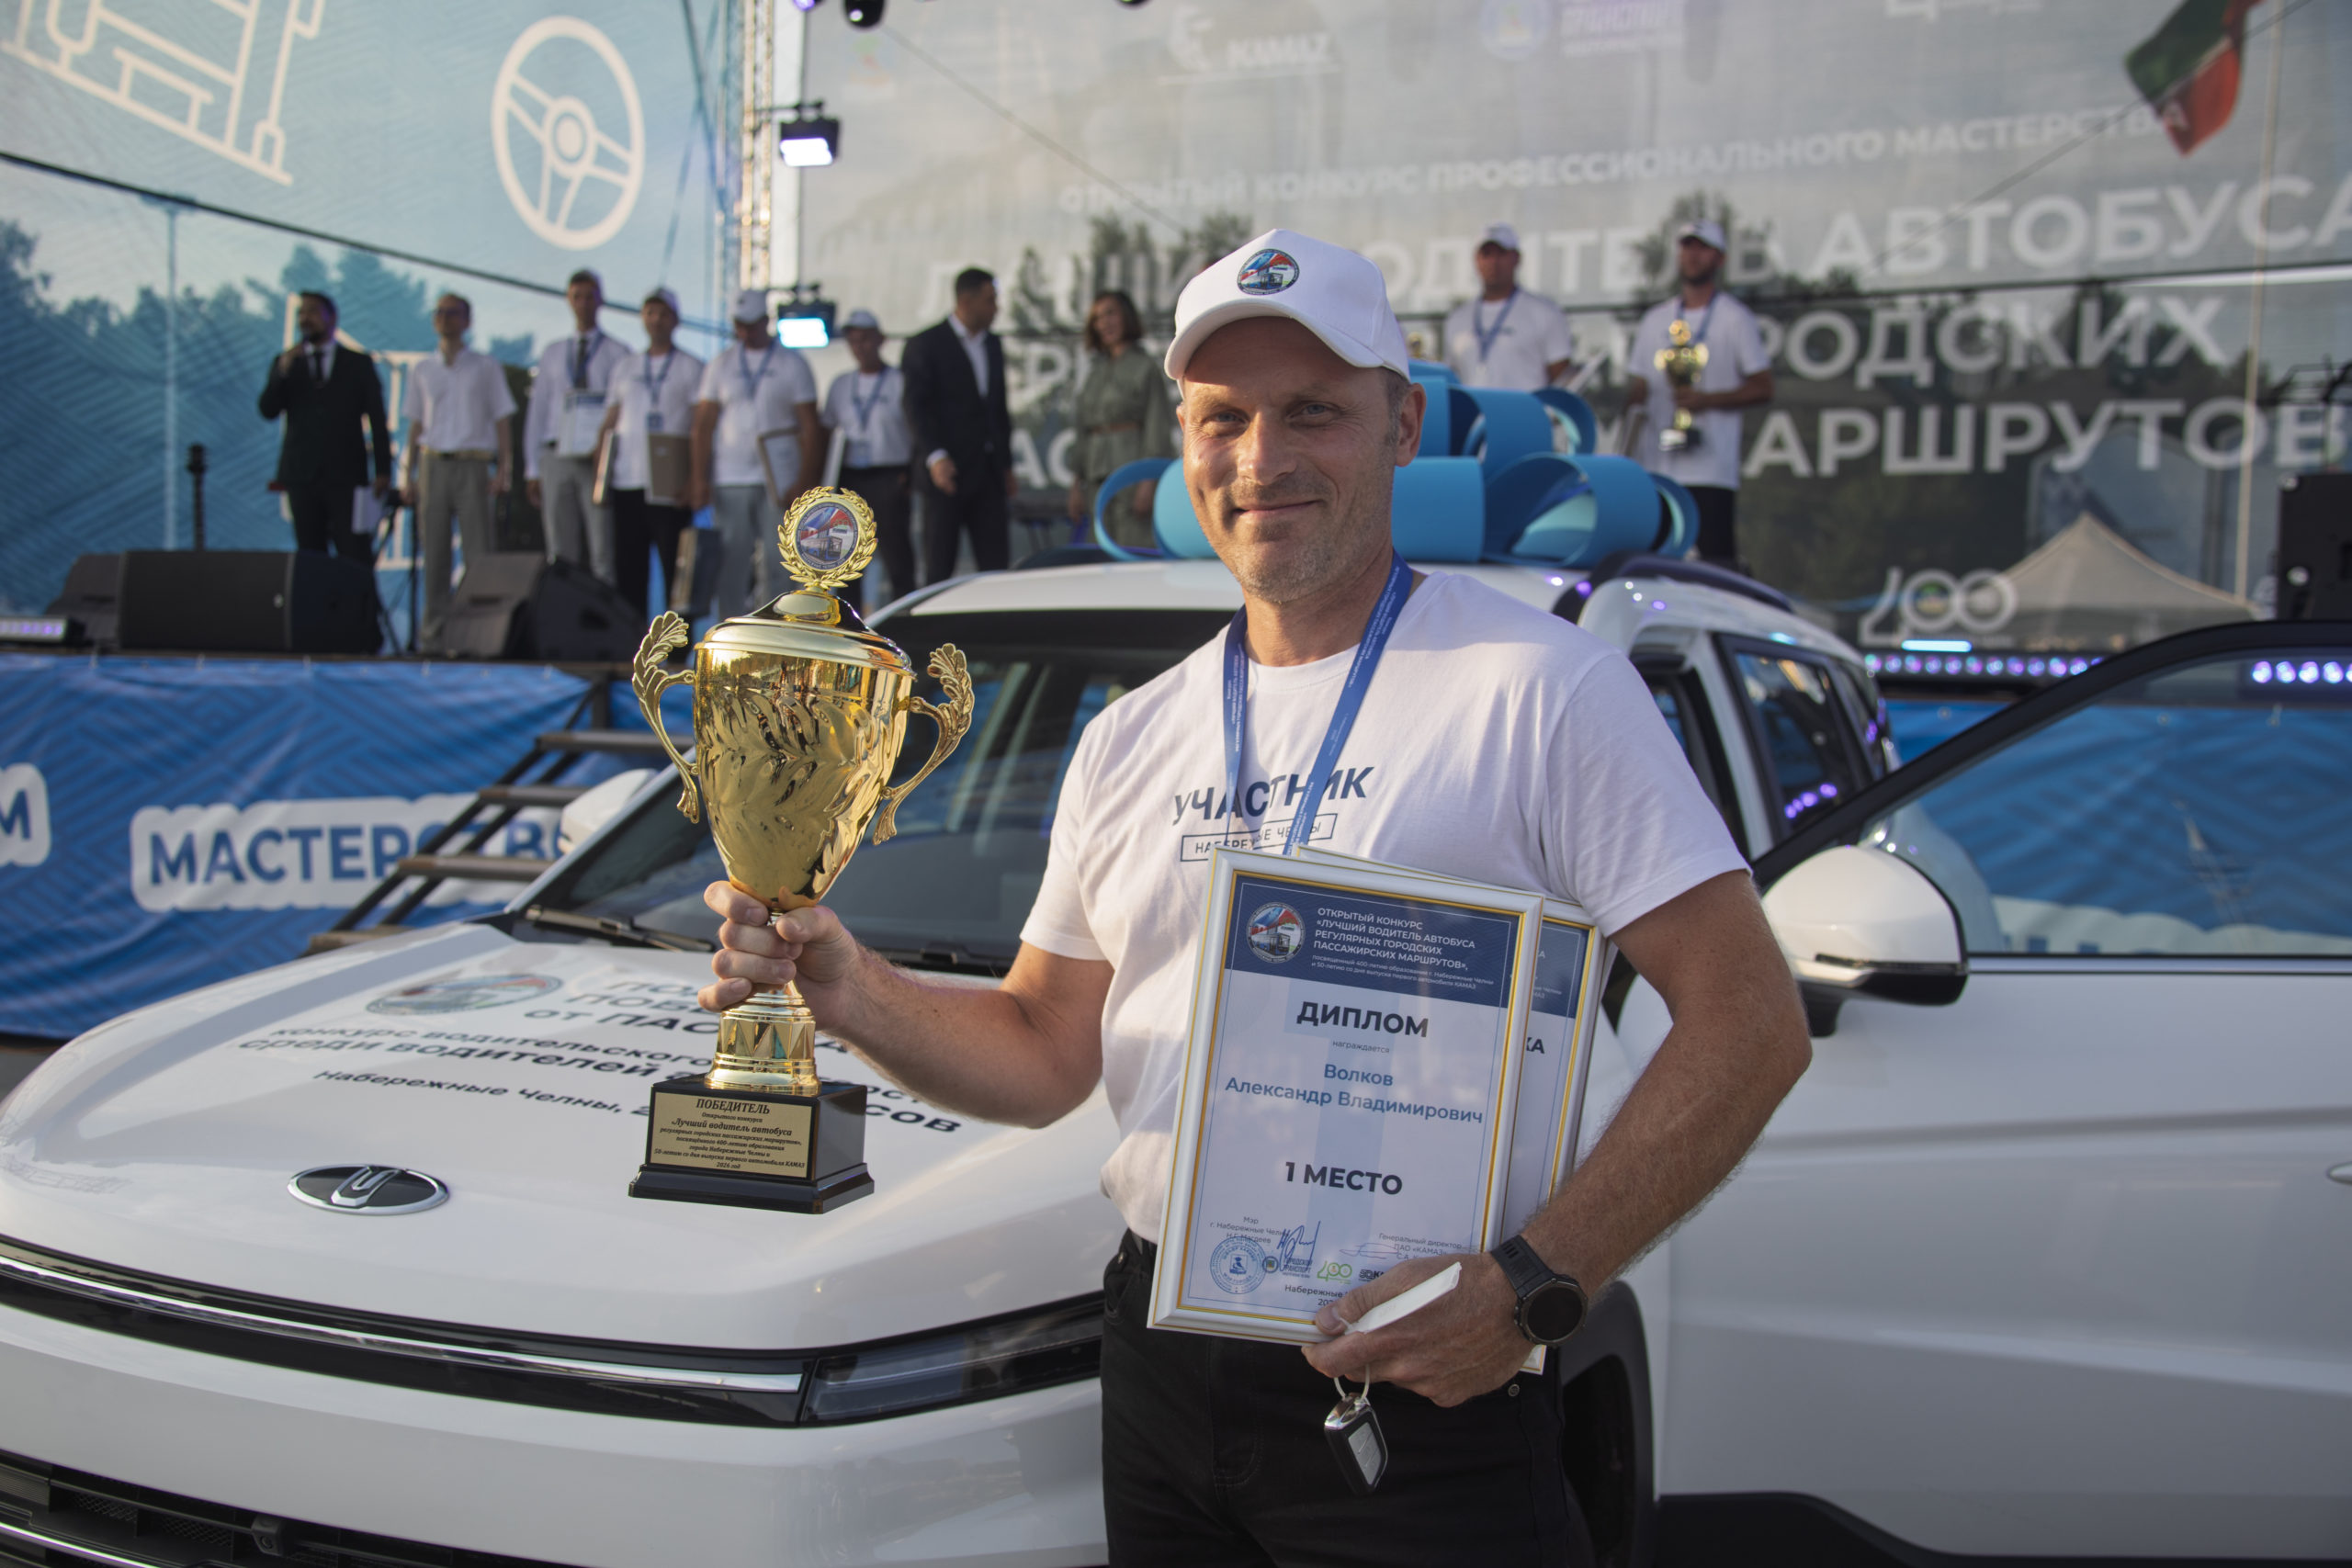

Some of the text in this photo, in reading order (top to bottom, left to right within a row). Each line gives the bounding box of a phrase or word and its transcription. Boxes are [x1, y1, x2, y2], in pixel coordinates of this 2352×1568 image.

[1258, 162, 1422, 200] КОНКУРС
[1427, 129, 1885, 191] ПРОФЕССИОНАЛЬНОГО
[1894, 103, 2187, 158] МАСТЕРСТВА
[1746, 396, 2331, 478] АРШРУТОВ
[1317, 908, 1423, 930] ОТКРЫТЫЙ КОНКУРС
[1315, 930, 1442, 955] РЕГУЛЯРНЫХ ГОРОДСКИХ
[1317, 919, 1476, 949] «ЛУЧШИЙ ВОДИТЕЛЬ АВТОБУСА
[1314, 940, 1469, 971] ПАССАЖИРСКИХ МАРШРУТОВ»,
[1434, 971, 1474, 982] Набережные
[1296, 1001, 1429, 1038] ДИПЛОМ
[1332, 1040, 1390, 1055] награждается
[1324, 1064, 1394, 1087] Волков
[313, 1069, 622, 1113] Набережные Челны,
[1225, 1077, 1483, 1123] Александр Владимирович
[695, 1098, 770, 1114] ПОБЕДИТЕЛЬ
[708, 1121, 750, 1133] водитель
[752, 1126, 793, 1137] автобуса
[785, 1160, 805, 1168] КАМАЗ
[1285, 1161, 1403, 1195] 1 МЕСТО
[1216, 1222, 1265, 1234] Набережные
[1243, 1216, 1259, 1224] Мэр
[1378, 1233, 1462, 1249] Генеральный директор
[1284, 1285, 1343, 1298] Набережные
